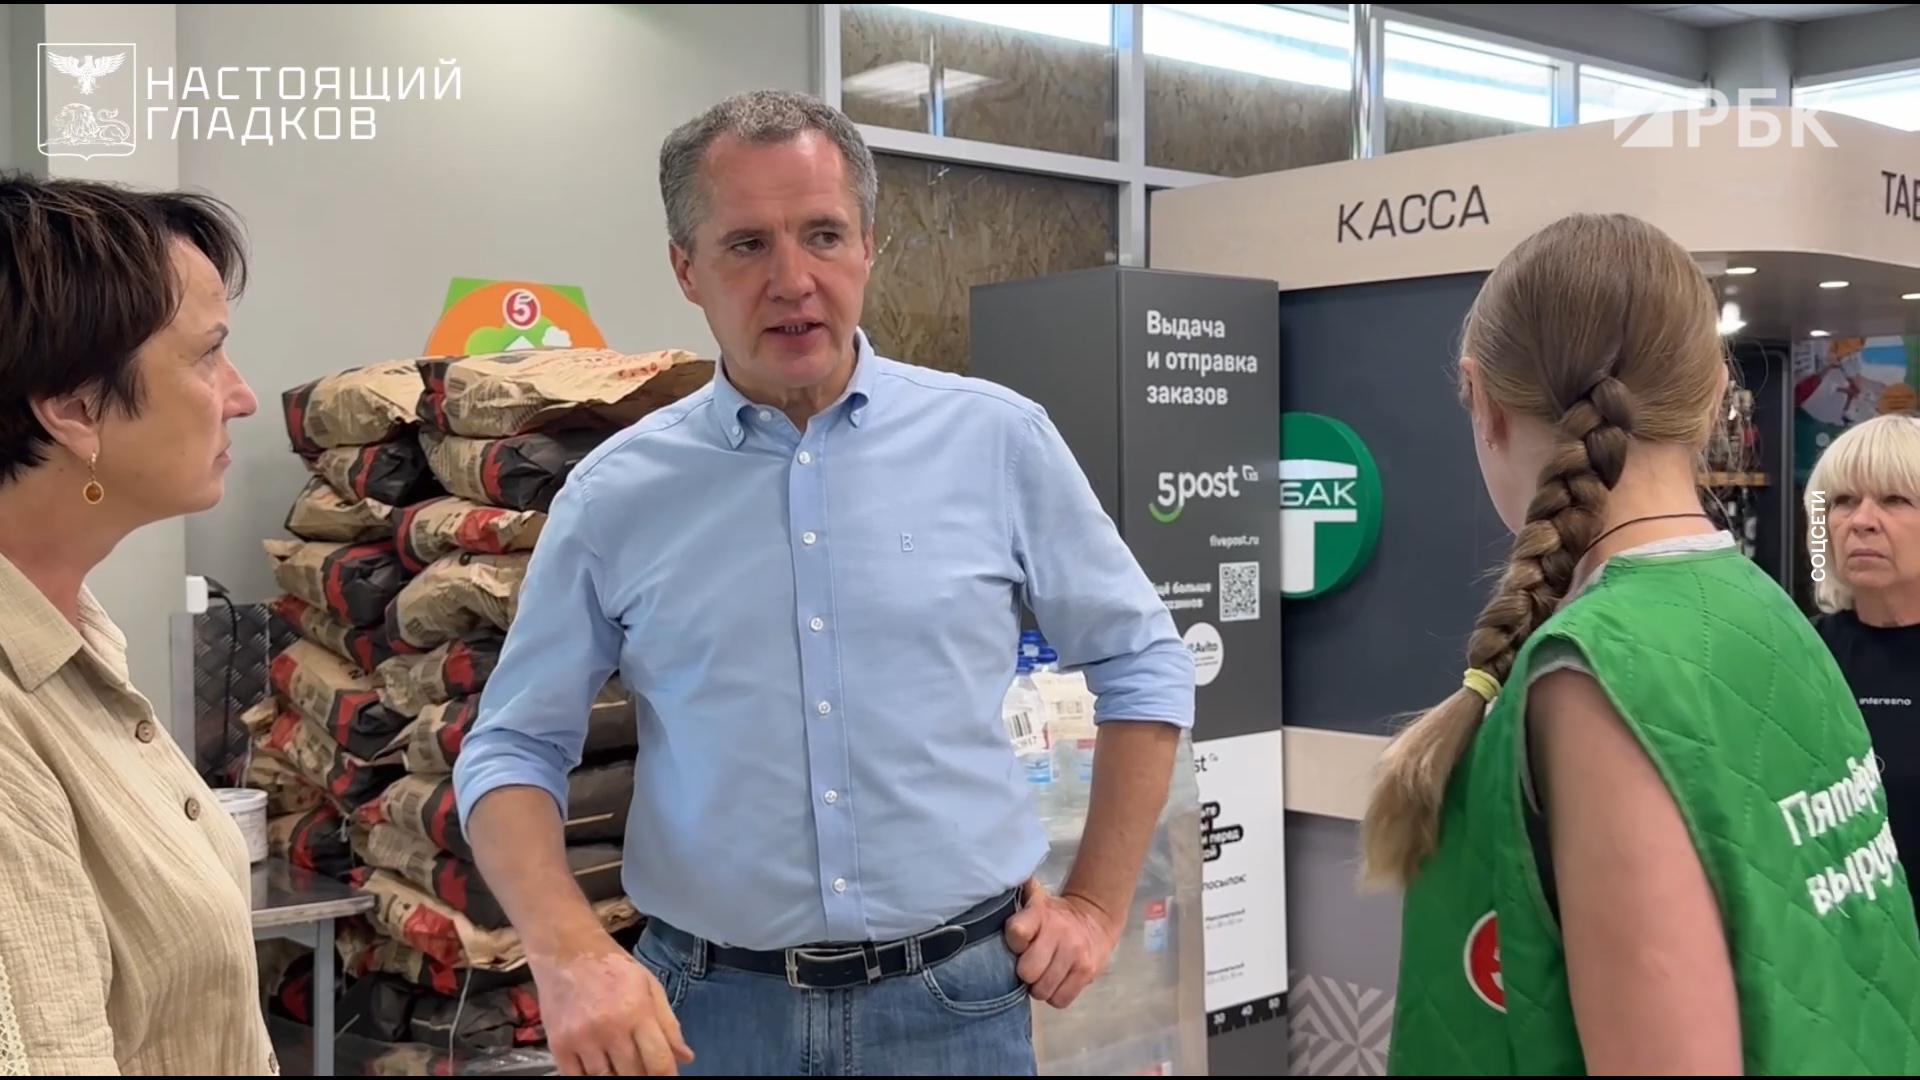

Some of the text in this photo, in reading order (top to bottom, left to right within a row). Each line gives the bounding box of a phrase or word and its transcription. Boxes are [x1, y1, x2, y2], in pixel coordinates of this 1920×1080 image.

[1338, 184, 1490, 243] КАССА
[1146, 310, 1226, 340] Выдача
[1147, 351, 1258, 378] и отправка
[1146, 385, 1228, 405] заказов
[1149, 465, 1240, 522] 5post
